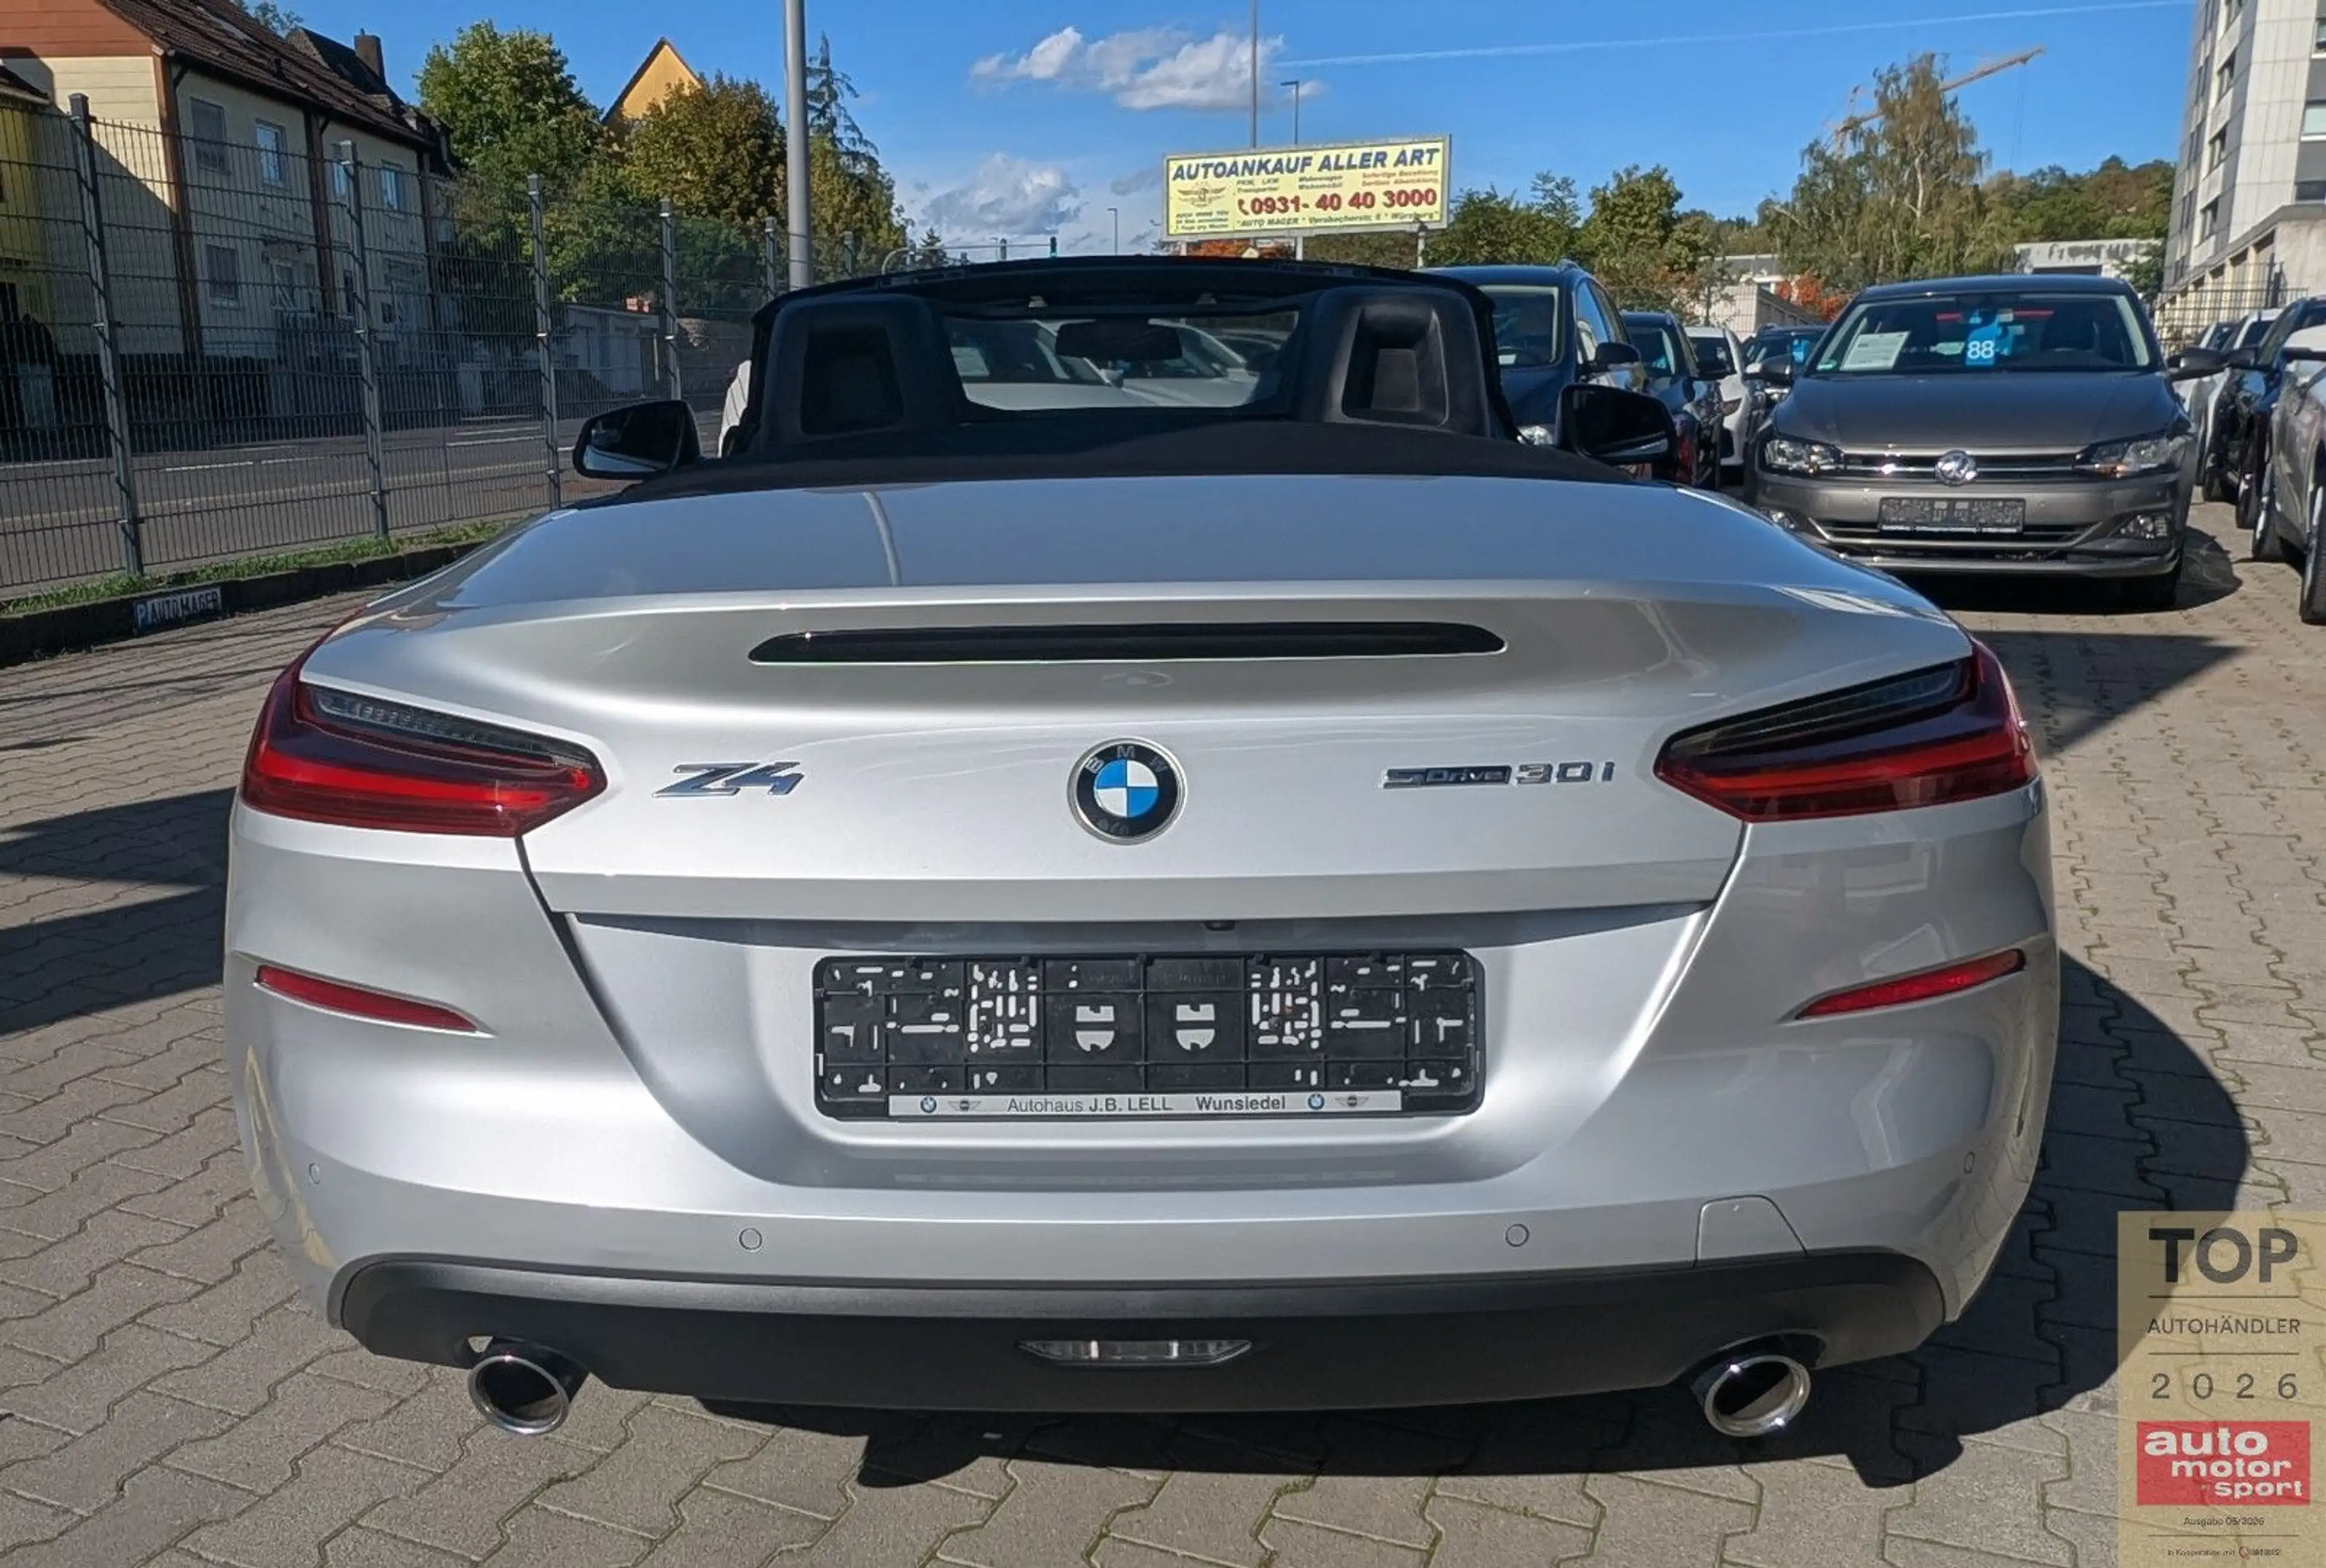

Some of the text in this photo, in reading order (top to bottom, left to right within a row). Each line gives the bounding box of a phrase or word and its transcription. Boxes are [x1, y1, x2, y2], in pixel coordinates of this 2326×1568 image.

[1173, 148, 1440, 180] AUTOANKAUF ALLER ART
[1315, 193, 1342, 211] 40
[1348, 191, 1376, 210] 40
[1382, 188, 1437, 208] 3000
[1967, 340, 1995, 359] 88
[1084, 746, 1168, 774] BMW
[652, 761, 804, 798] Z4
[1007, 1096, 1285, 1113] Autohaus J.B. LELL Wunsiedel
